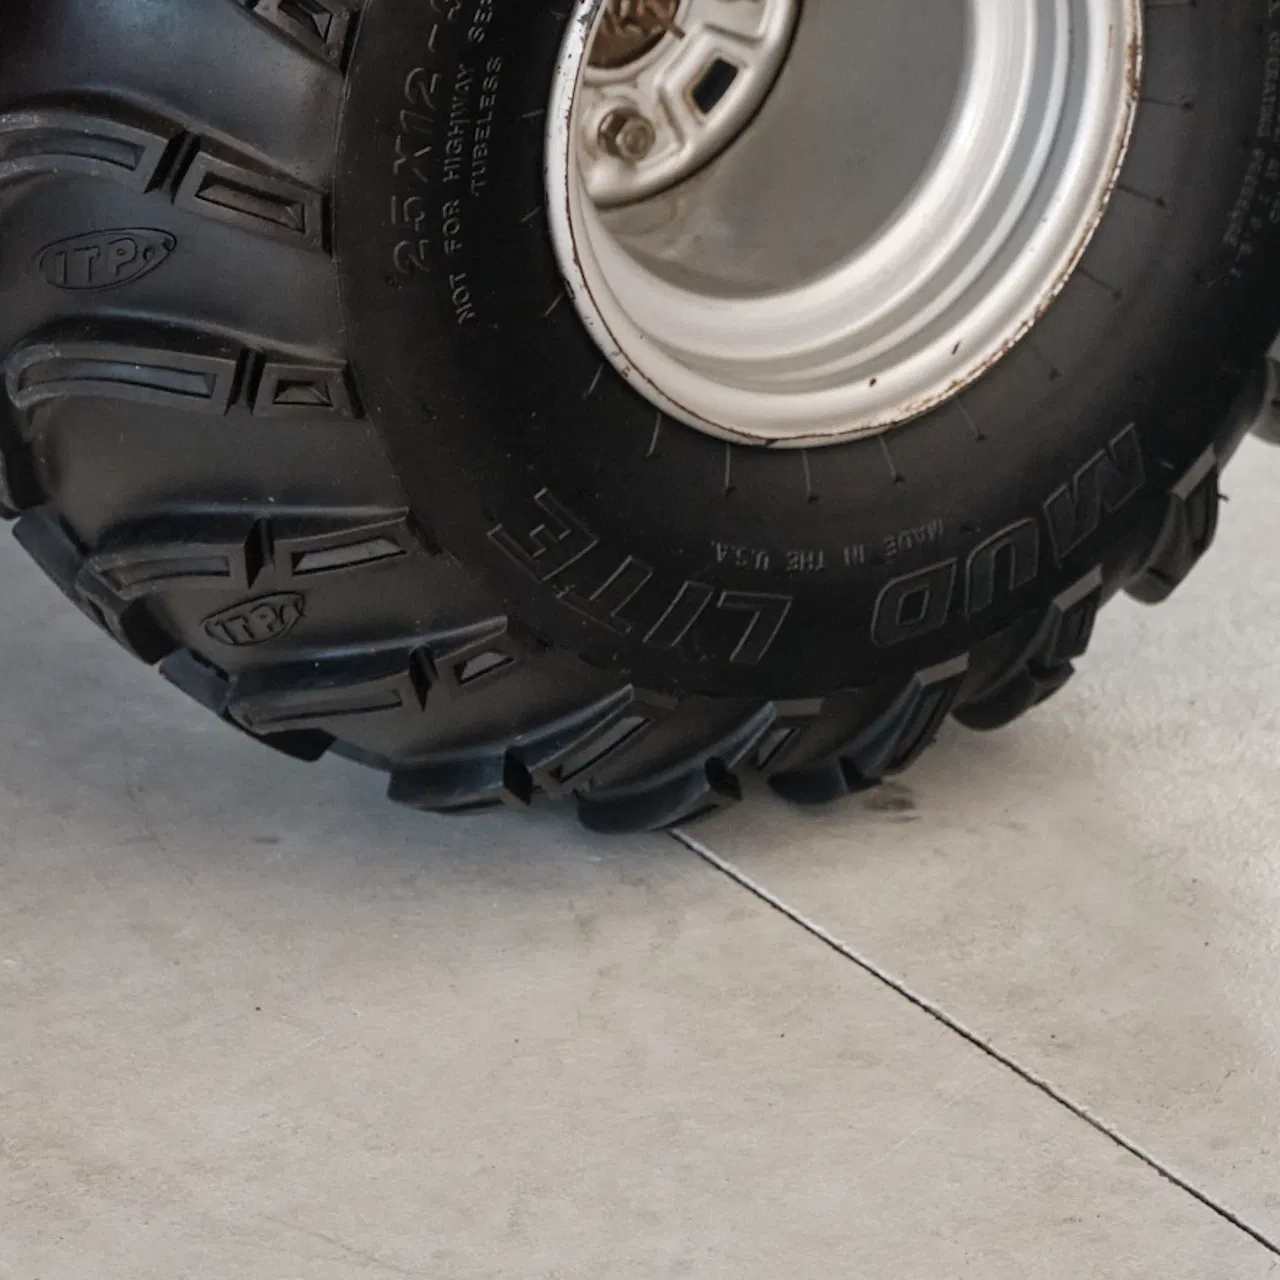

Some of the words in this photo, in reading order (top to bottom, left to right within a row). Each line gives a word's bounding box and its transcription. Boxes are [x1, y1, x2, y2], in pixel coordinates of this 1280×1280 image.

[442, 62, 473, 183] HIGHWAY
[470, 55, 503, 197] TUBELESS
[442, 199, 464, 255] FOR
[56, 237, 138, 285] ITP
[448, 272, 476, 325] NOT
[843, 543, 866, 567] IN
[871, 420, 1146, 649] MUD
[883, 518, 944, 560] MADE
[486, 486, 794, 665] LITE
